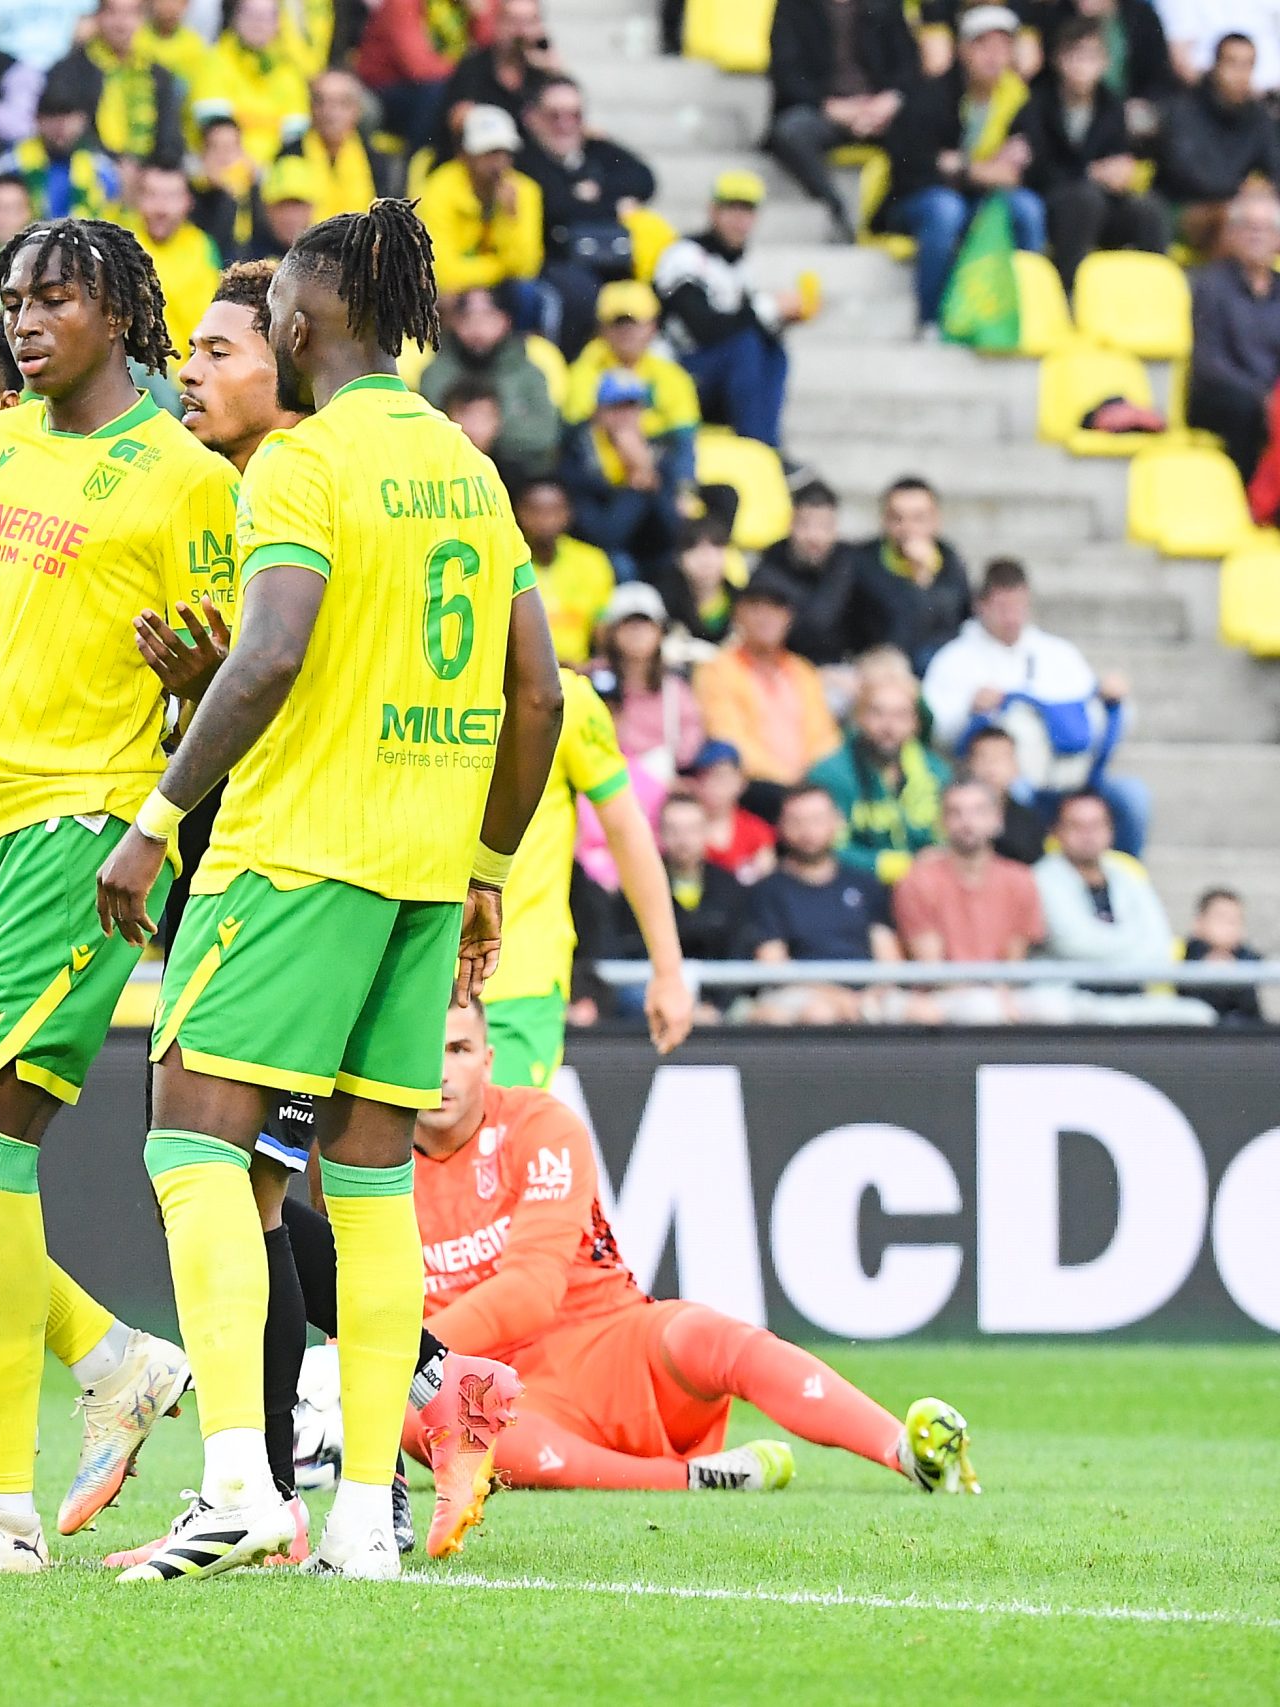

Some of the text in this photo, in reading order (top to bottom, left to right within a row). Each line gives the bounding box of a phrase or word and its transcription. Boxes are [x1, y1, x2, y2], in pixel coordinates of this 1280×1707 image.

[32, 553, 67, 579] CDI
[423, 538, 480, 681] 6
[380, 703, 501, 746] MILLET
[434, 751, 449, 768] et
[423, 1215, 511, 1273] NERGI
